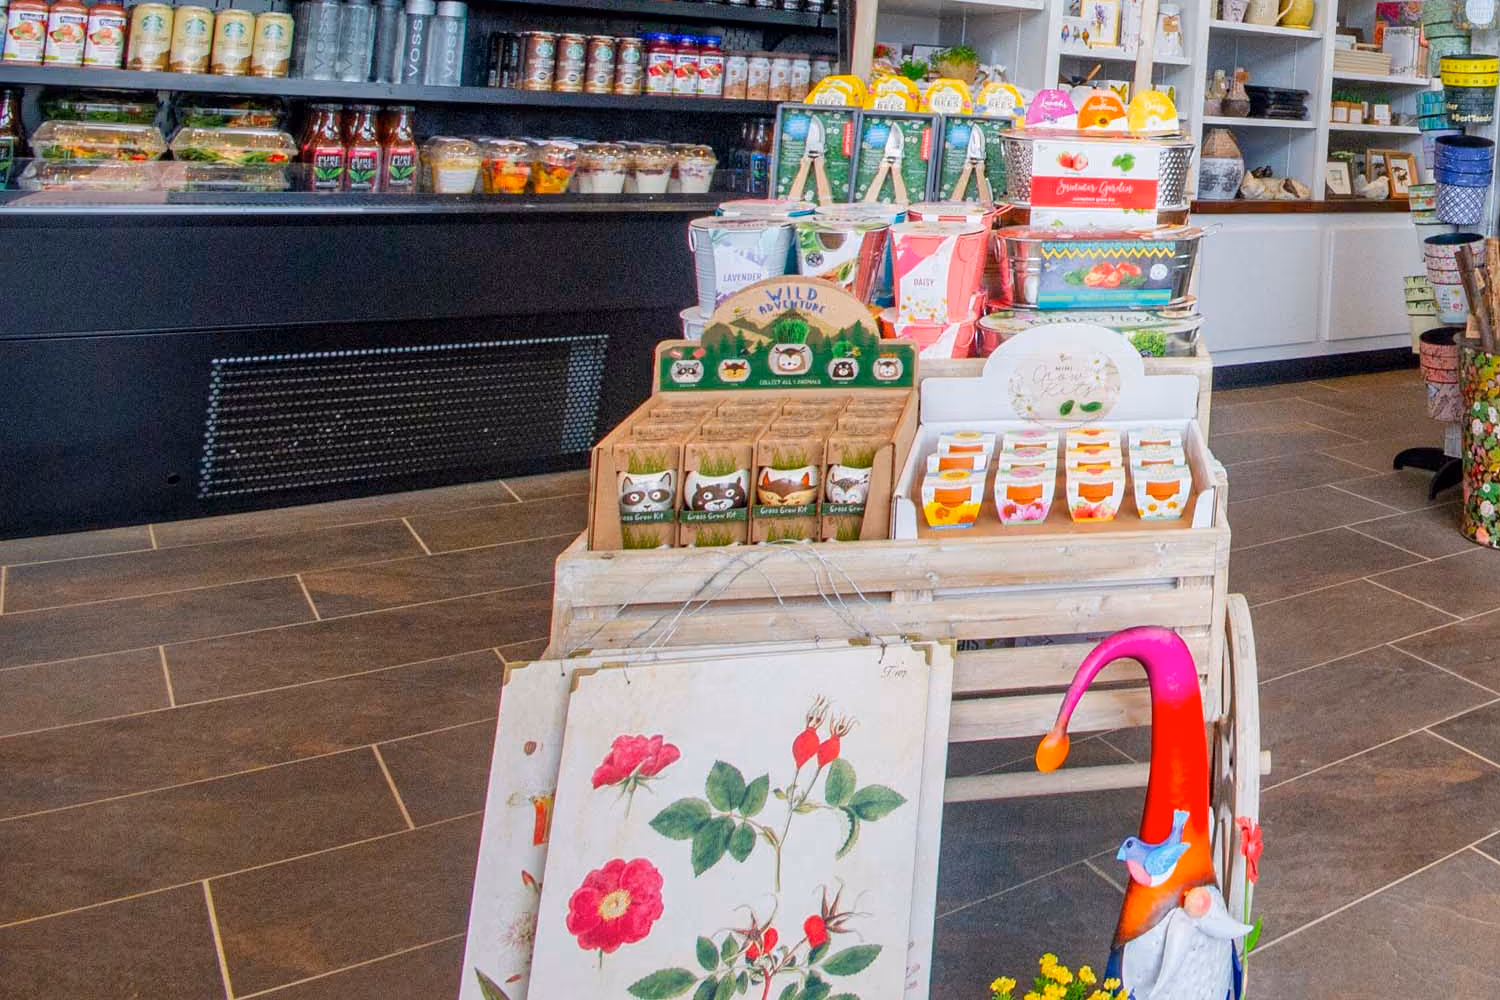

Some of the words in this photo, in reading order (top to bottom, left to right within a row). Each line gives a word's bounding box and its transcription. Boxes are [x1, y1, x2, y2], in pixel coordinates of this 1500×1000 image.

[409, 18, 423, 77] VOSS
[442, 21, 459, 79] VOSS
[1056, 179, 1098, 195] Summer
[1098, 179, 1134, 196] Garden
[723, 271, 762, 283] LAVENDER
[913, 278, 935, 288] DAISY
[766, 285, 819, 302] WILD
[758, 301, 827, 316] ADVENTURE
